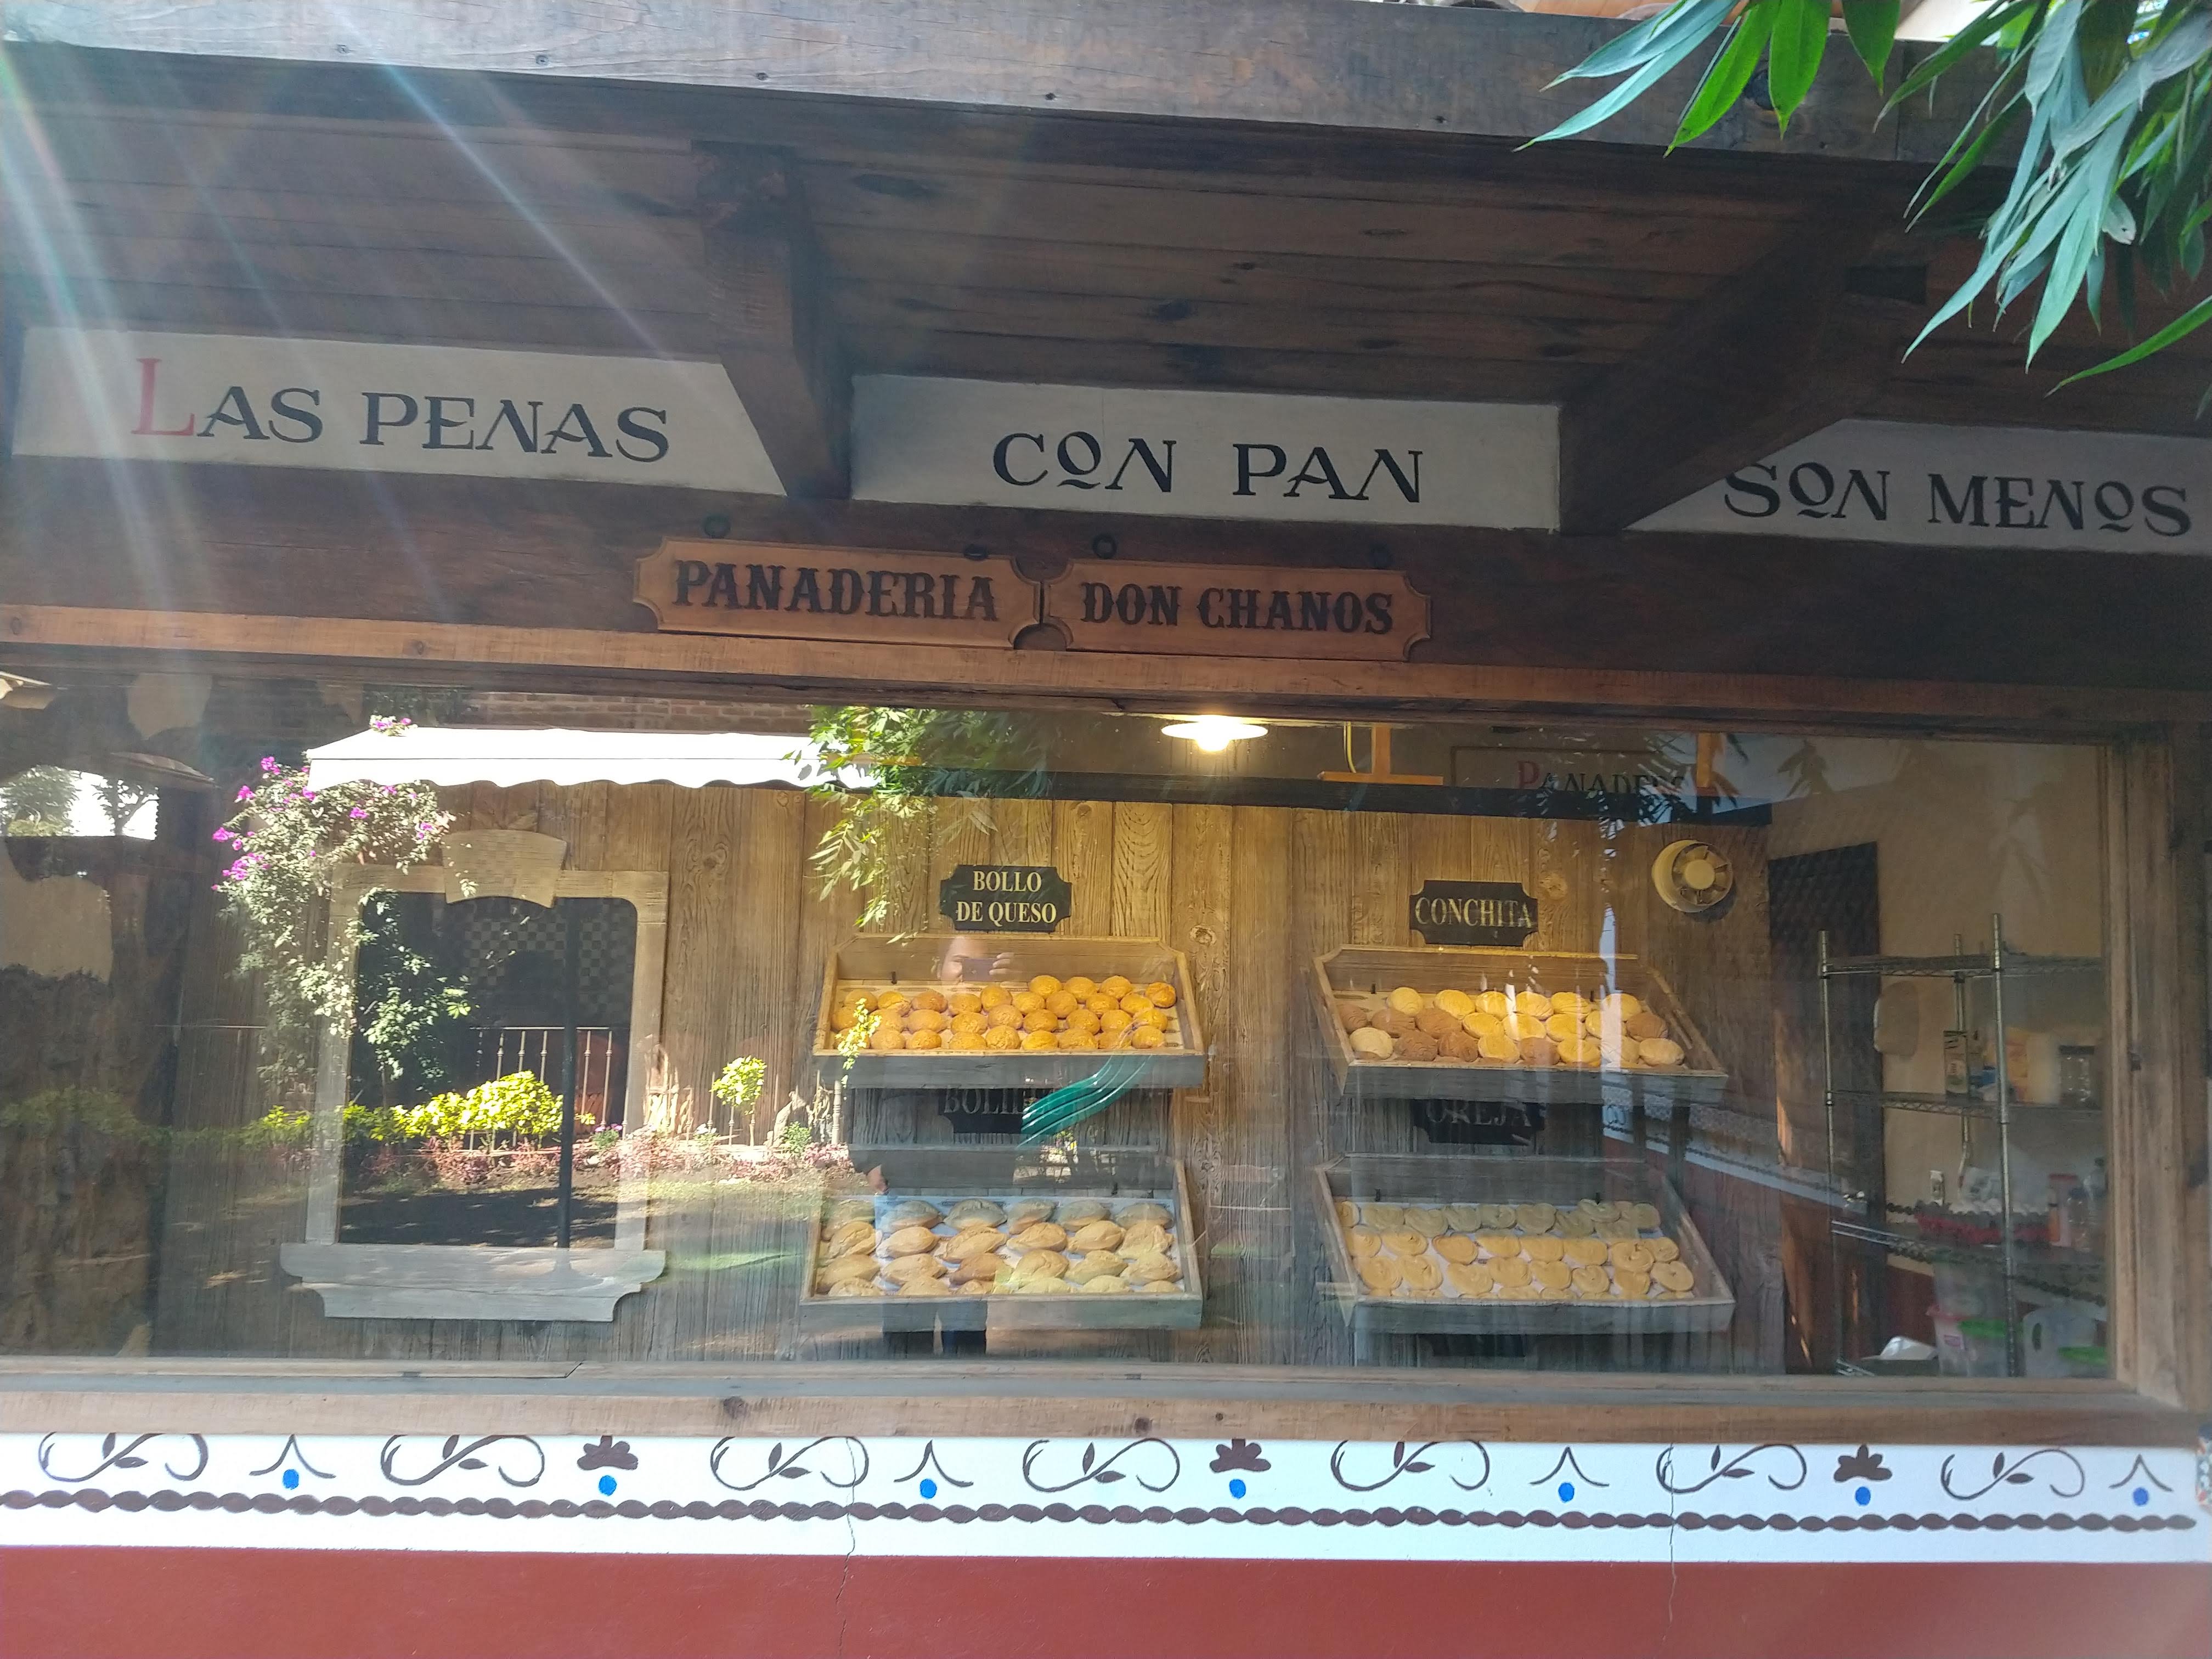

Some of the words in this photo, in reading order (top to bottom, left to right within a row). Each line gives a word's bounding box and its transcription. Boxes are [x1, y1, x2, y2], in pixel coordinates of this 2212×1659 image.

[131, 358, 323, 443] LAS
[360, 391, 670, 463] PENAS
[993, 431, 1176, 493] CON
[1233, 443, 1423, 503] PAN
[1725, 461, 1891, 521] SON
[1927, 473, 2192, 537] MENOS
[672, 560, 999, 622] PANADERIA
[1080, 582, 1182, 626] DON
[1197, 588, 1393, 635] CHANOS
[973, 871, 1042, 893] BOLLO
[956, 901, 983, 922] DE
[989, 901, 1057, 927] QUESO
[1415, 896, 1532, 928] CONCHITA
